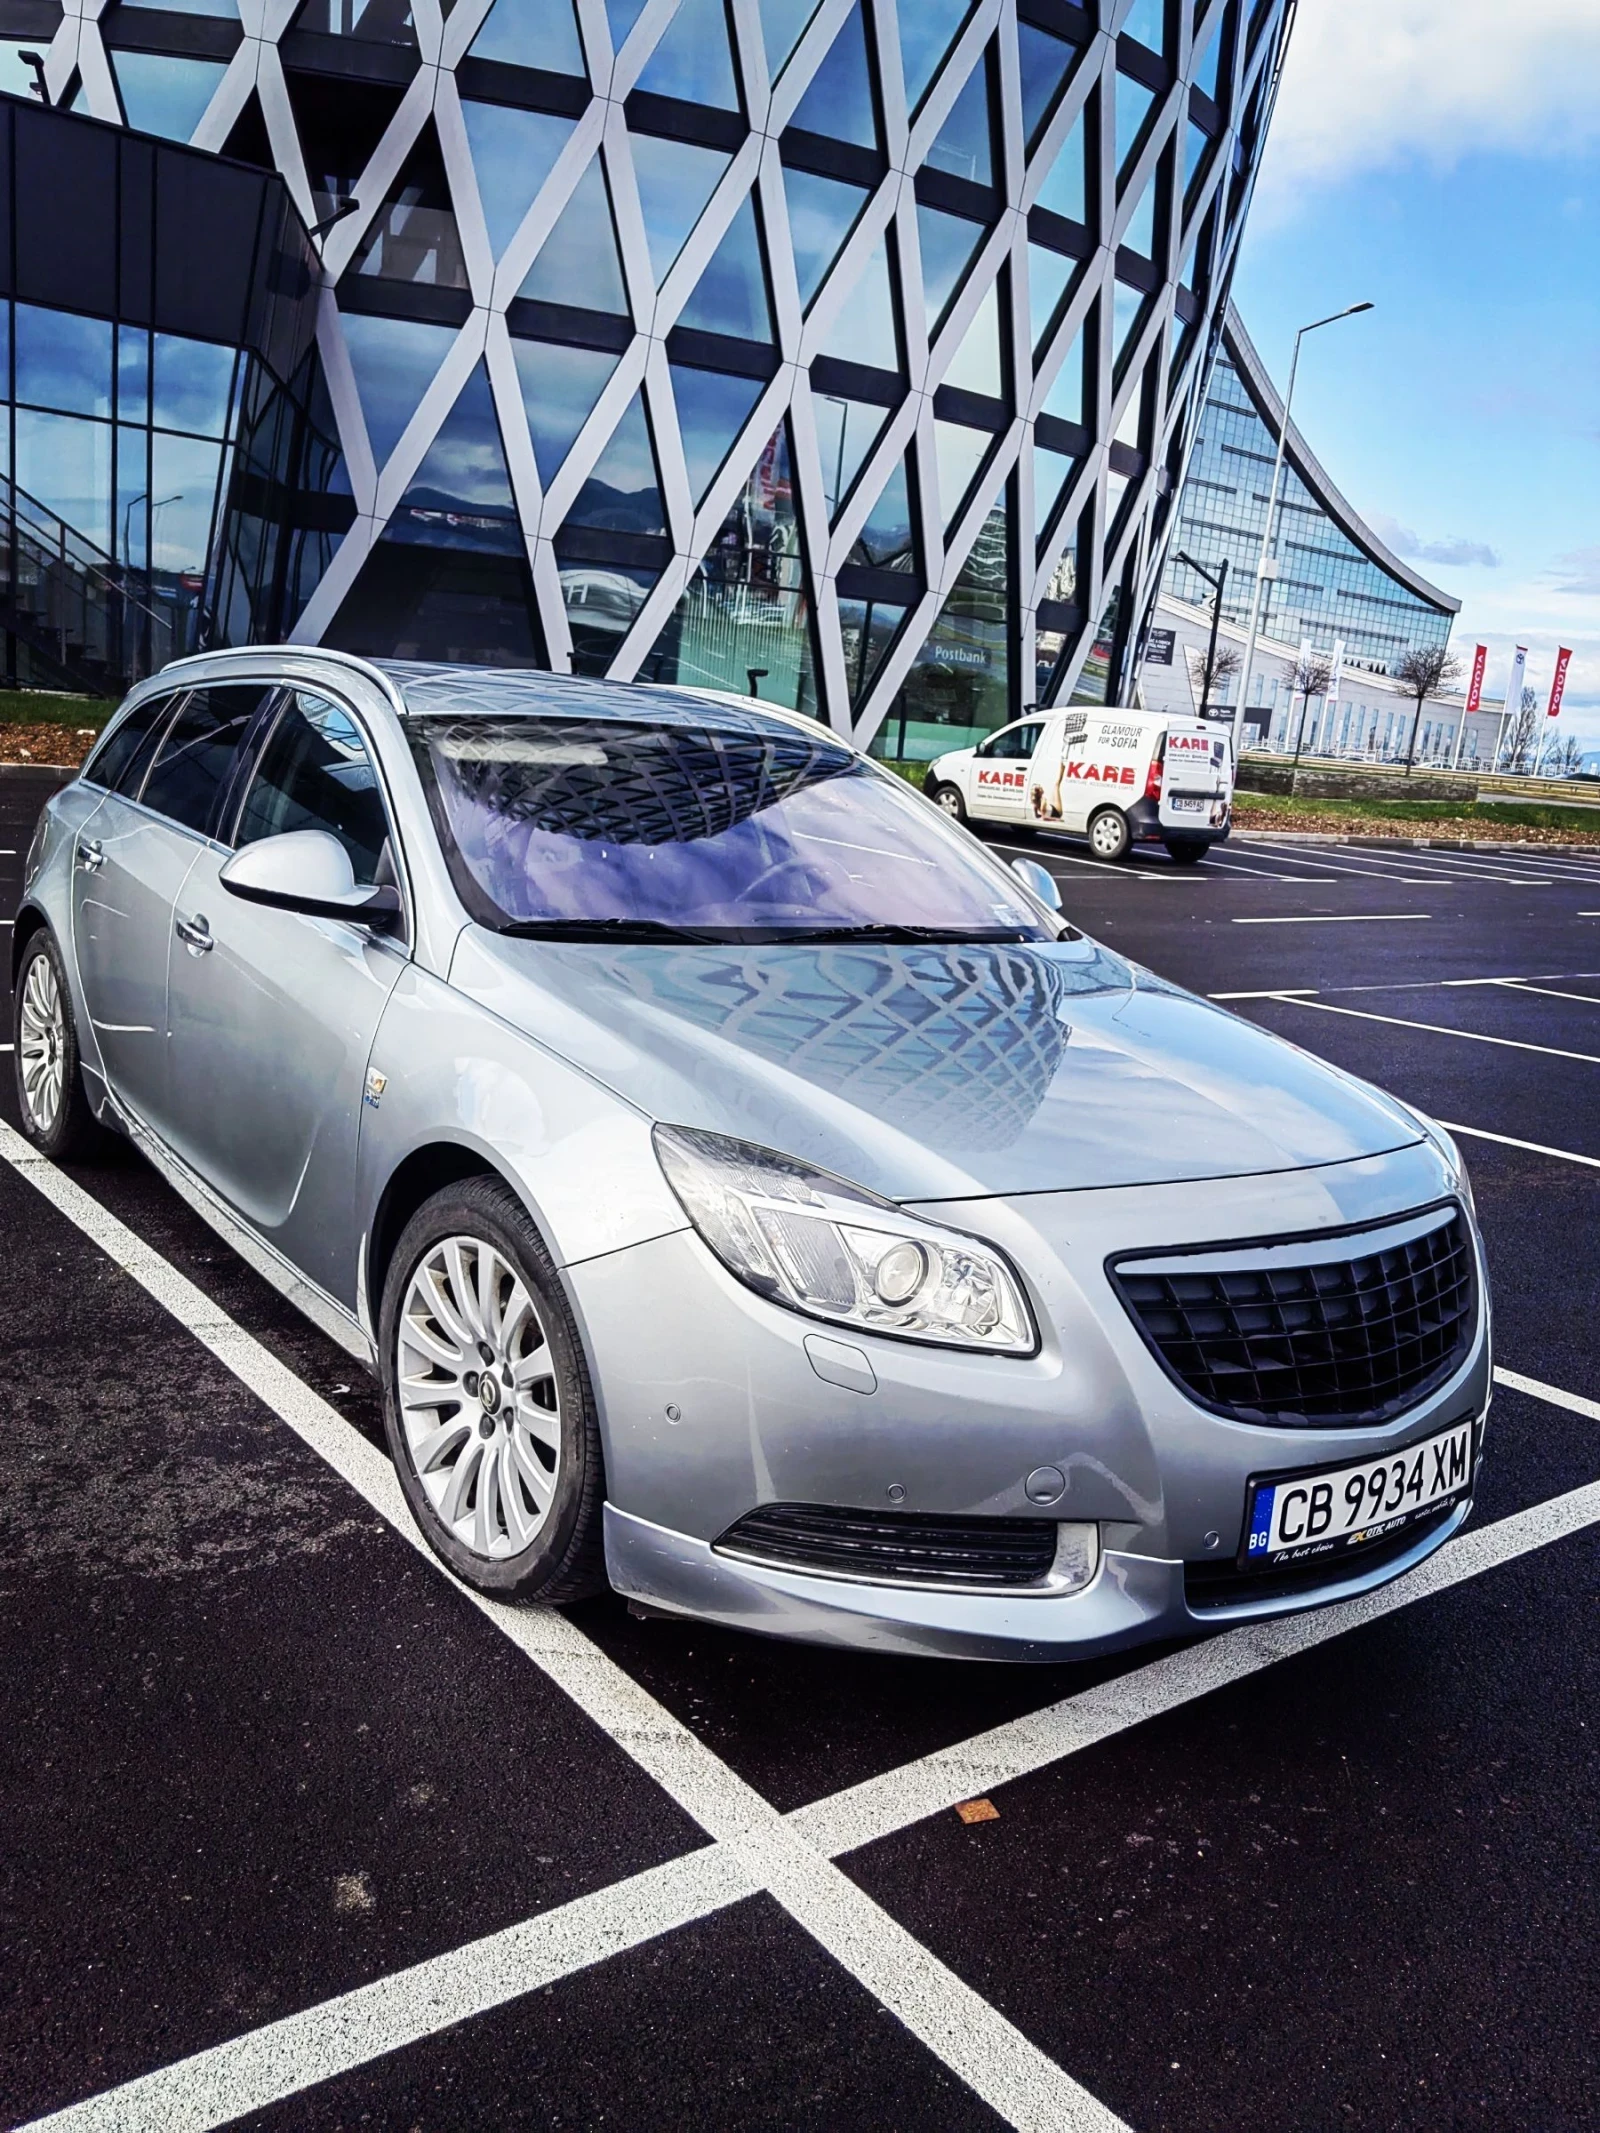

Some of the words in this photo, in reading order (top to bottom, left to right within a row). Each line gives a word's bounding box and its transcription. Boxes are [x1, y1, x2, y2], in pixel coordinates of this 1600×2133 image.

[935, 645, 986, 664] Postbank
[1469, 654, 1484, 707] TOYOTA
[1551, 658, 1568, 711] TOYOTA
[1101, 725, 1143, 737] GLAMOUR
[1098, 736, 1110, 745] FOR
[1110, 736, 1138, 749] SOFIA
[1169, 736, 1209, 752] KARE
[978, 770, 1025, 787] KARE
[1066, 761, 1136, 785] KARE
[1279, 1483, 1333, 1543] CB
[1345, 1450, 1424, 1527] 9934
[1430, 1431, 1467, 1496] XM
[1346, 1524, 1386, 1545] EXOTIC
[1385, 1516, 1407, 1531] AUTO
[1248, 1531, 1268, 1550] BG
[1273, 1551, 1290, 1563] The
[1292, 1547, 1311, 1559] best
